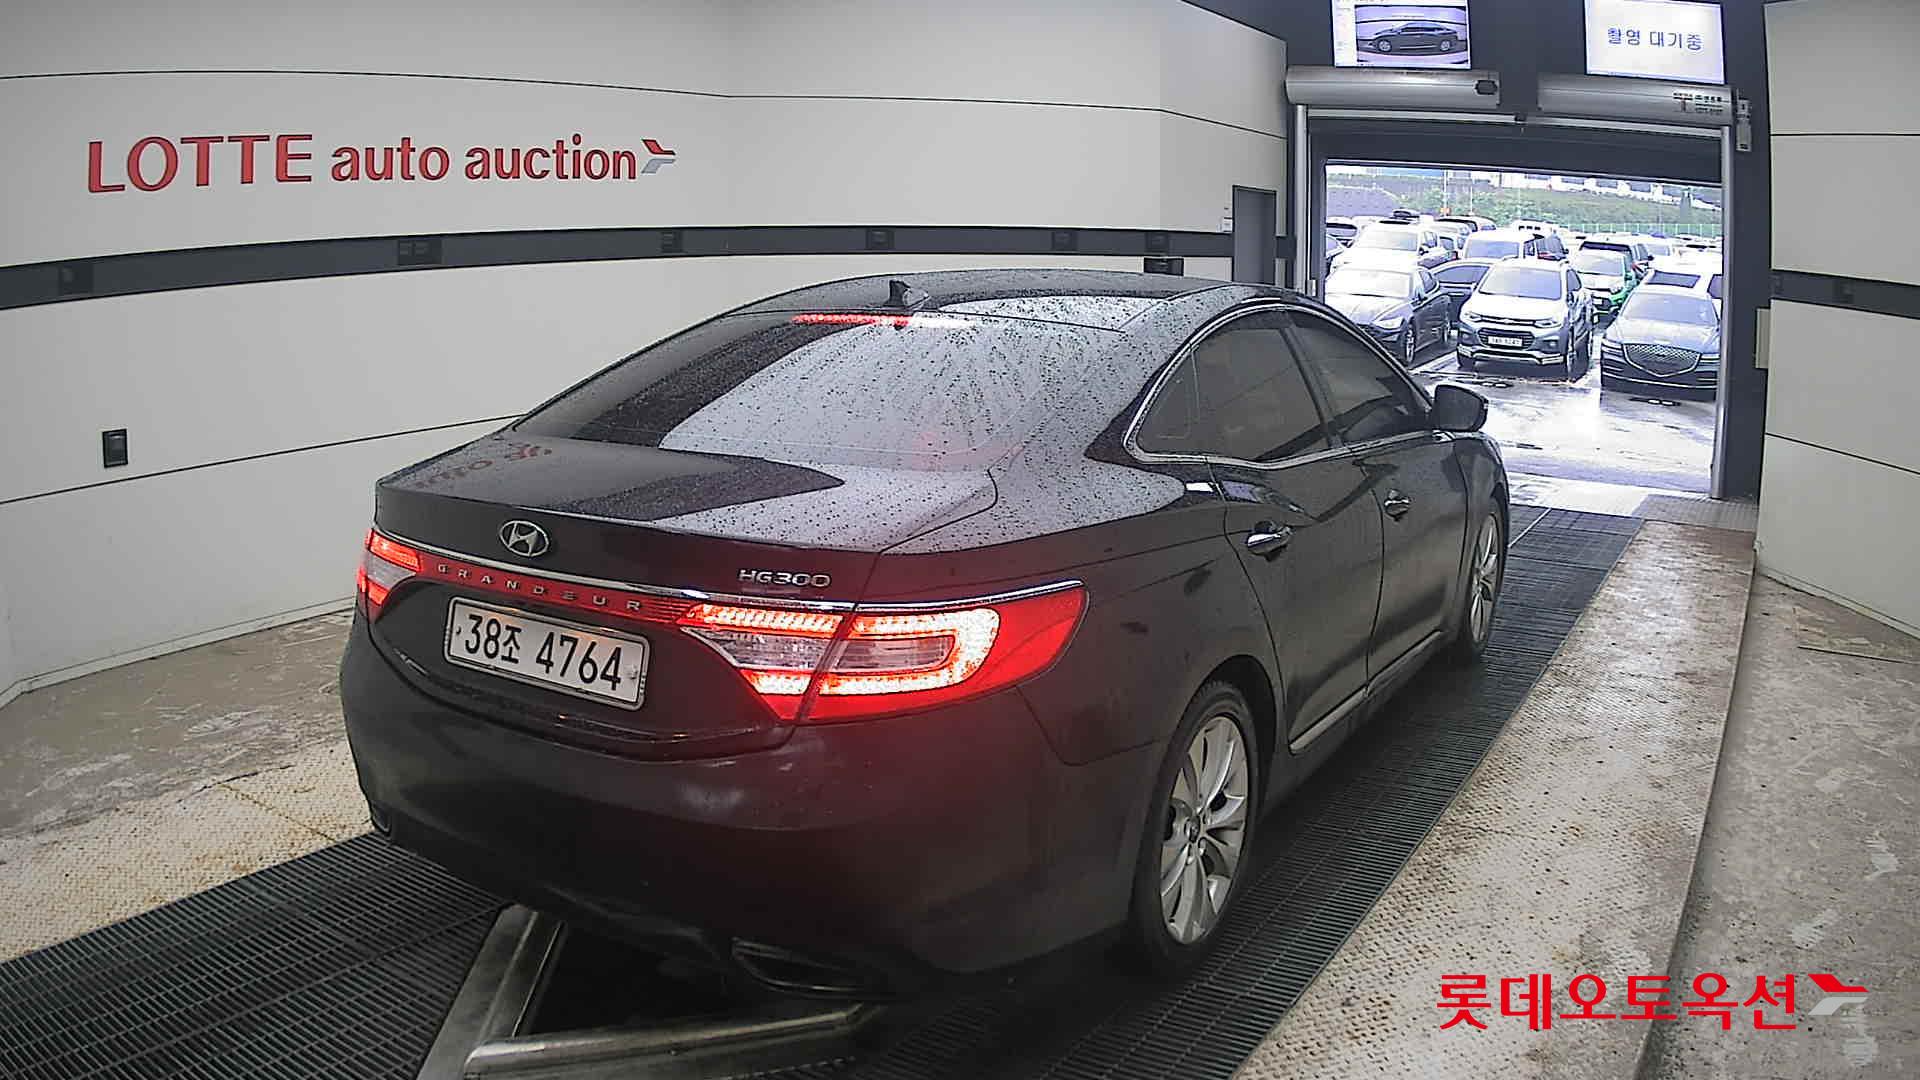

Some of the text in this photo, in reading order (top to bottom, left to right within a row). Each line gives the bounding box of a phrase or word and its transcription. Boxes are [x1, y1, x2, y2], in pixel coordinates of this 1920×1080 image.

[1607, 27, 1702, 51] 촬영 대기중
[88, 132, 637, 194] LOTTE auto auction
[437, 563, 641, 612] GRANDEUR
[739, 569, 831, 587] HG300
[464, 614, 622, 692] 38조 4764
